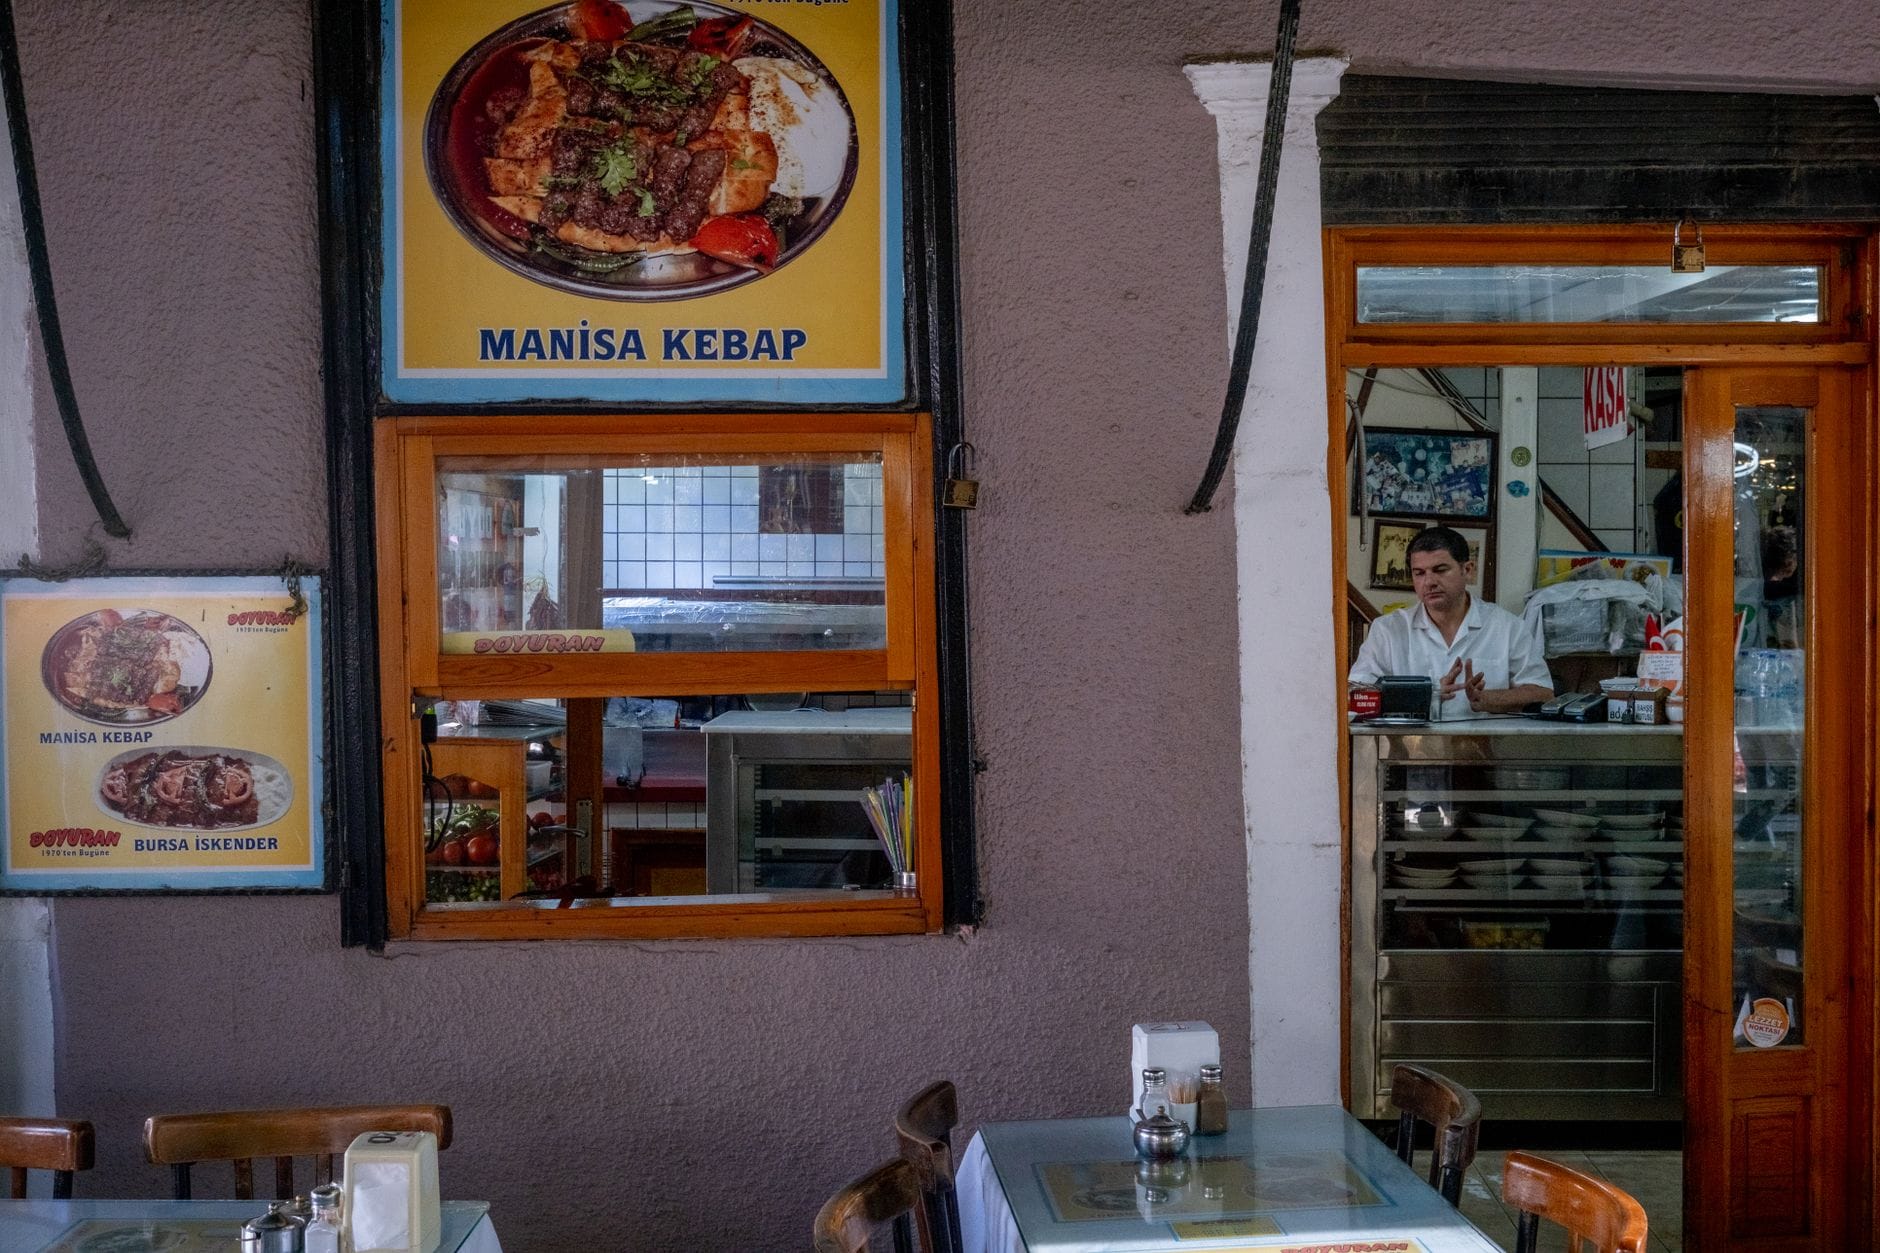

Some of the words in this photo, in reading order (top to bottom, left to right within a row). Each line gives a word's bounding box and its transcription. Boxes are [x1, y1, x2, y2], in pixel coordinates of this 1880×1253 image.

[479, 319, 647, 360] MANİSA
[661, 329, 807, 360] KEBAP
[1584, 367, 1625, 434] KASA
[474, 634, 605, 653] DOYURAN
[40, 729, 97, 744] MANİSA
[102, 731, 153, 743] KEBAP
[30, 828, 121, 848] DOYURAN
[134, 838, 189, 851] BURSA
[195, 835, 278, 850] İSKENDER
[1749, 1014, 1783, 1029] LEZZET
